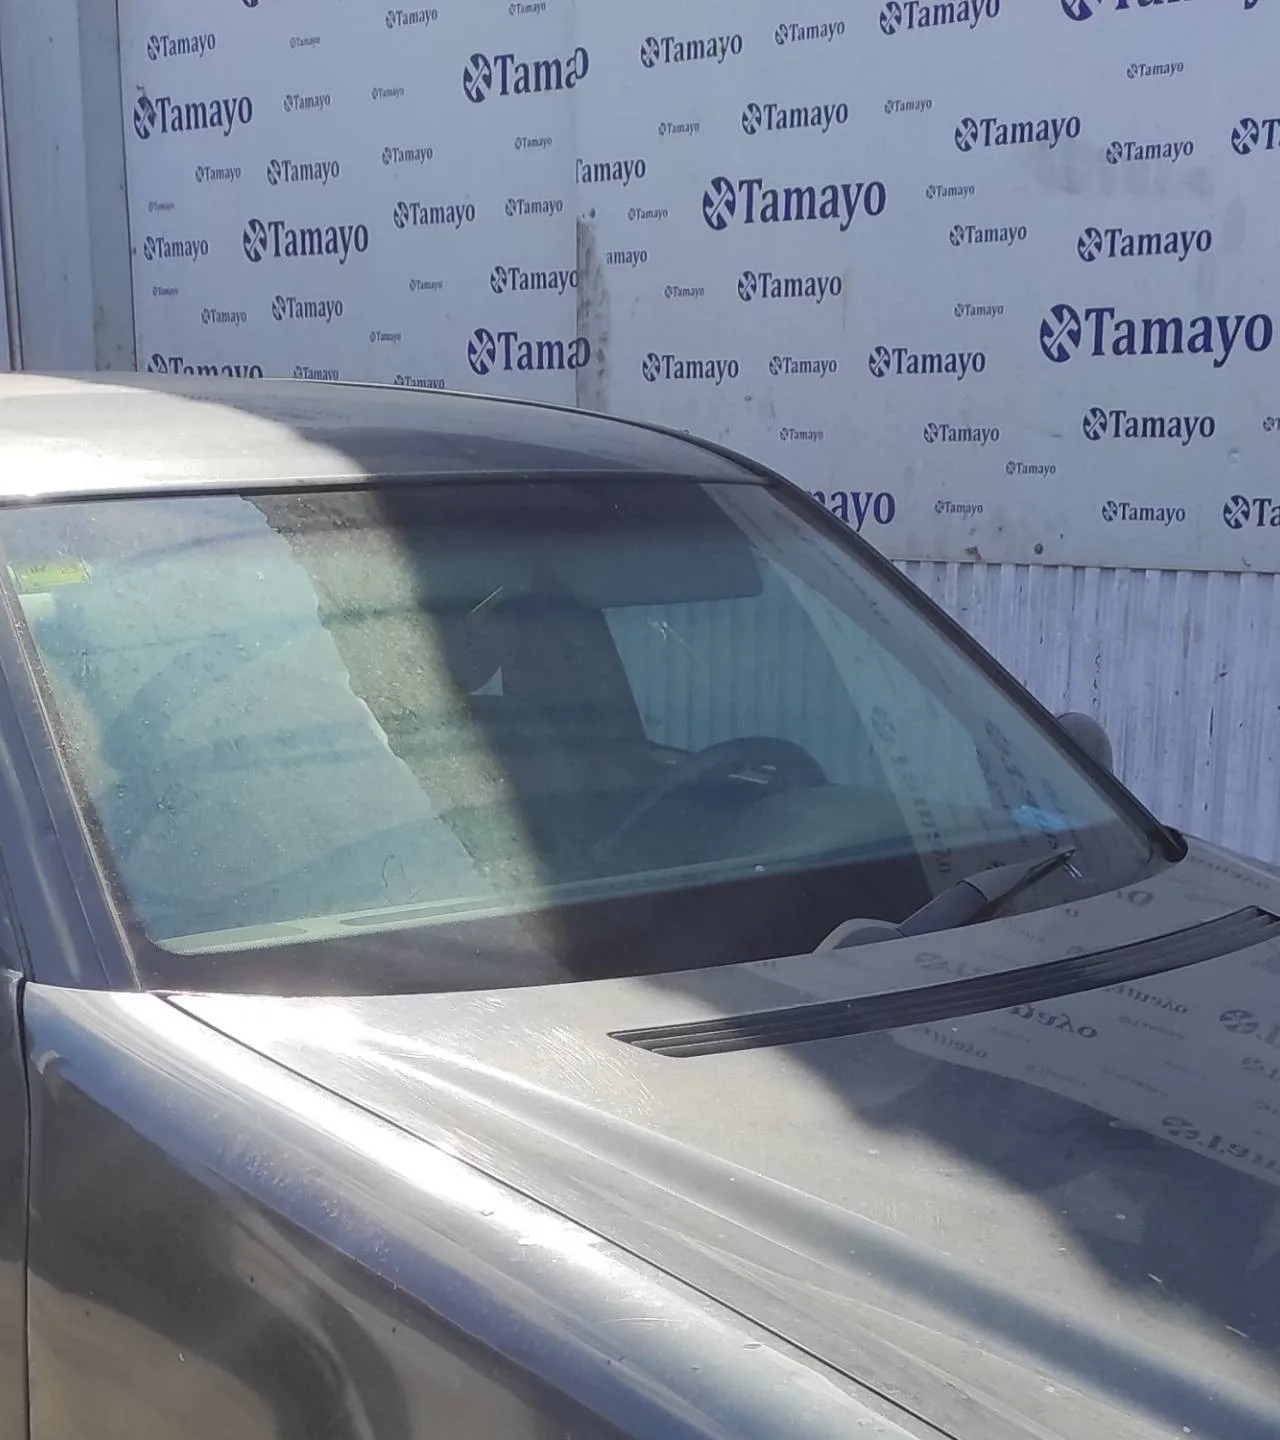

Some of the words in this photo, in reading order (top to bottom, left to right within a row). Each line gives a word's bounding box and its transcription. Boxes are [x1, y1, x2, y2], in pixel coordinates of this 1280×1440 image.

[396, 9, 437, 26] Tamayo
[904, 0, 999, 29] Tamayo
[789, 22, 845, 42] Tamayo
[160, 34, 215, 57] Tamayo
[661, 35, 742, 64] Tamayo
[1140, 63, 1183, 76] Tamayo
[293, 95, 330, 110] Tamayo
[892, 100, 932, 112] Tamayo
[156, 97, 252, 136] Tamayo
[763, 104, 848, 133] Tamayo
[980, 117, 1080, 149] Tamayo
[392, 148, 433, 164] Tamayo
[1124, 141, 1193, 162] Tamayo
[203, 167, 241, 182] Tamayo
[282, 160, 339, 185] Tamayo
[936, 185, 975, 199] Tamayo
[409, 203, 475, 229] Tamayo
[517, 199, 563, 216] Tamayo
[739, 179, 885, 231] Tamayo
[268, 221, 368, 264] Tamayo
[965, 226, 1026, 246] Tamayo
[1105, 229, 1211, 262] Tamayo
[156, 237, 208, 262] Tamayo
[759, 273, 841, 304] Tamayo
[211, 309, 247, 326] Tamayo
[286, 297, 342, 323] Tamayo
[963, 304, 1003, 318] Tamayo
[1085, 308, 1272, 368] Tamayo
[662, 355, 738, 385] Tamayo
[783, 357, 837, 378] Tamayo
[892, 348, 985, 380] Tamayo
[789, 429, 823, 442] Tamayo
[939, 424, 999, 446] Tamayo
[1109, 410, 1215, 446] Tamayo
[1016, 462, 1056, 477] Tamayo
[945, 501, 983, 517] Tamayo
[1119, 503, 1185, 526] Tamayo
